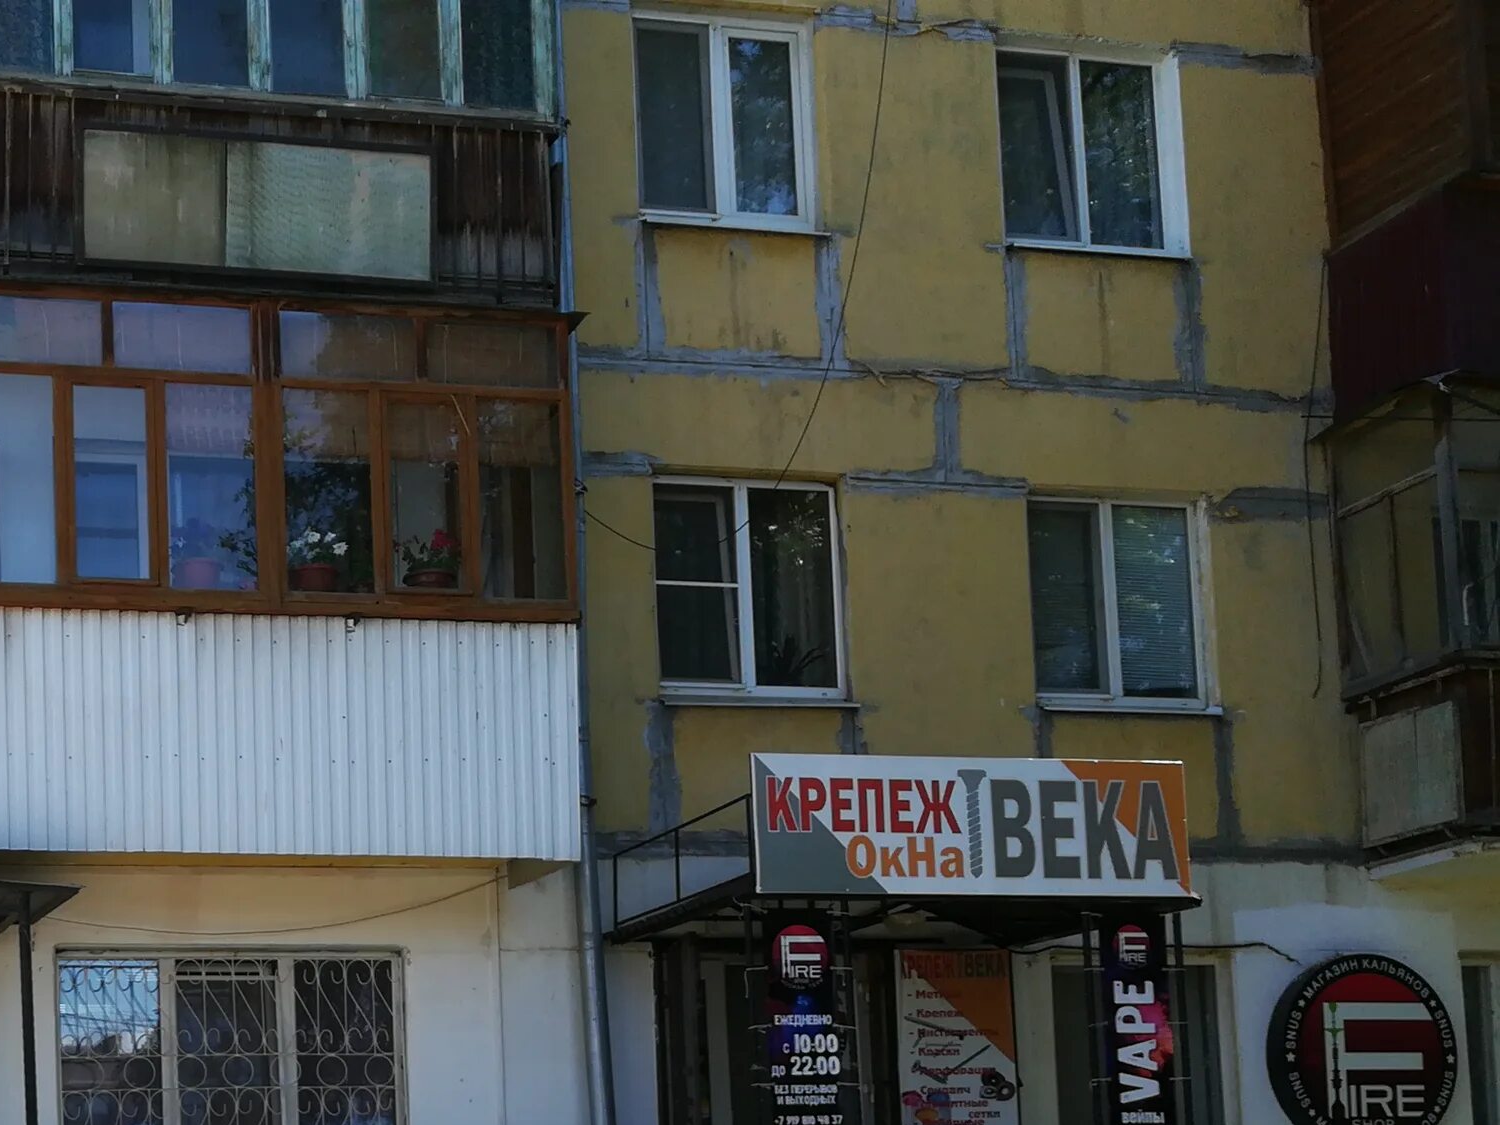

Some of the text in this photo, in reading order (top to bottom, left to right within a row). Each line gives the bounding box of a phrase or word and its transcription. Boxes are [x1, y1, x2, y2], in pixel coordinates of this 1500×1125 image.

[765, 775, 1181, 880] КРЕПЕЖ ВЕКА
[1303, 958, 1429, 1001] МАГАЗИН КАЛЬЯНОВ
[773, 1013, 833, 1027] ЕЖЕДНЕВНО
[1285, 1010, 1302, 1050] SNUS
[1434, 1009, 1454, 1049] SNUS
[793, 1033, 840, 1054] 10:00
[1113, 979, 1161, 1105] VAPE
[1322, 1002, 1434, 1120] FIRE
[789, 1055, 841, 1076] 22:00
[1288, 1071, 1311, 1110] SNUS
[1437, 1070, 1455, 1107] SNUS
